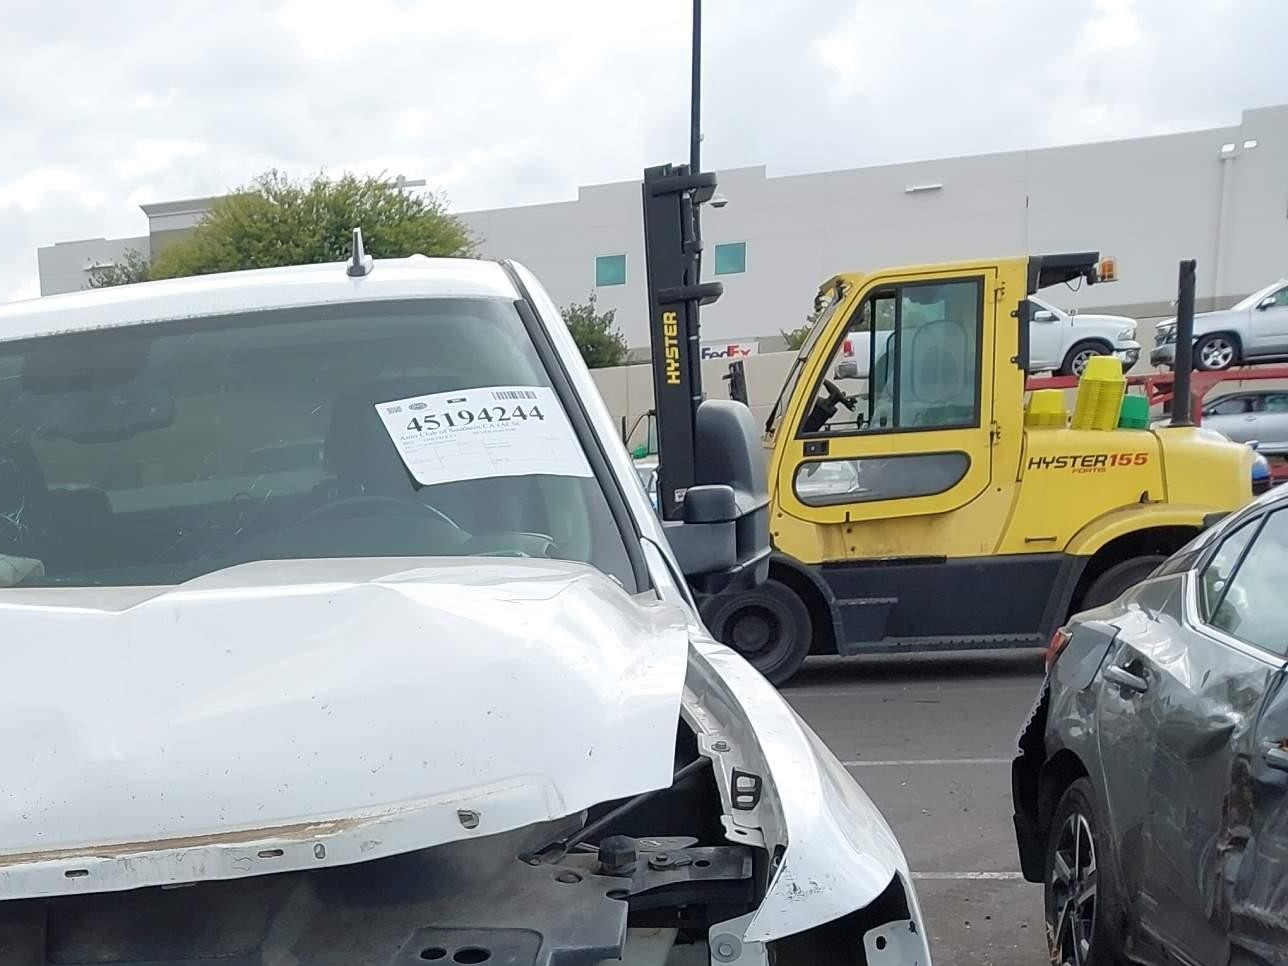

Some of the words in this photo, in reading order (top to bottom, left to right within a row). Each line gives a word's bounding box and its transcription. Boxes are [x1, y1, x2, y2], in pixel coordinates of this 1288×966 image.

[663, 311, 681, 385] HYSTER
[701, 344, 751, 359] FedEx
[406, 405, 545, 432] 45194244
[1028, 454, 1108, 470] HYSTER
[1109, 452, 1149, 467] 155
